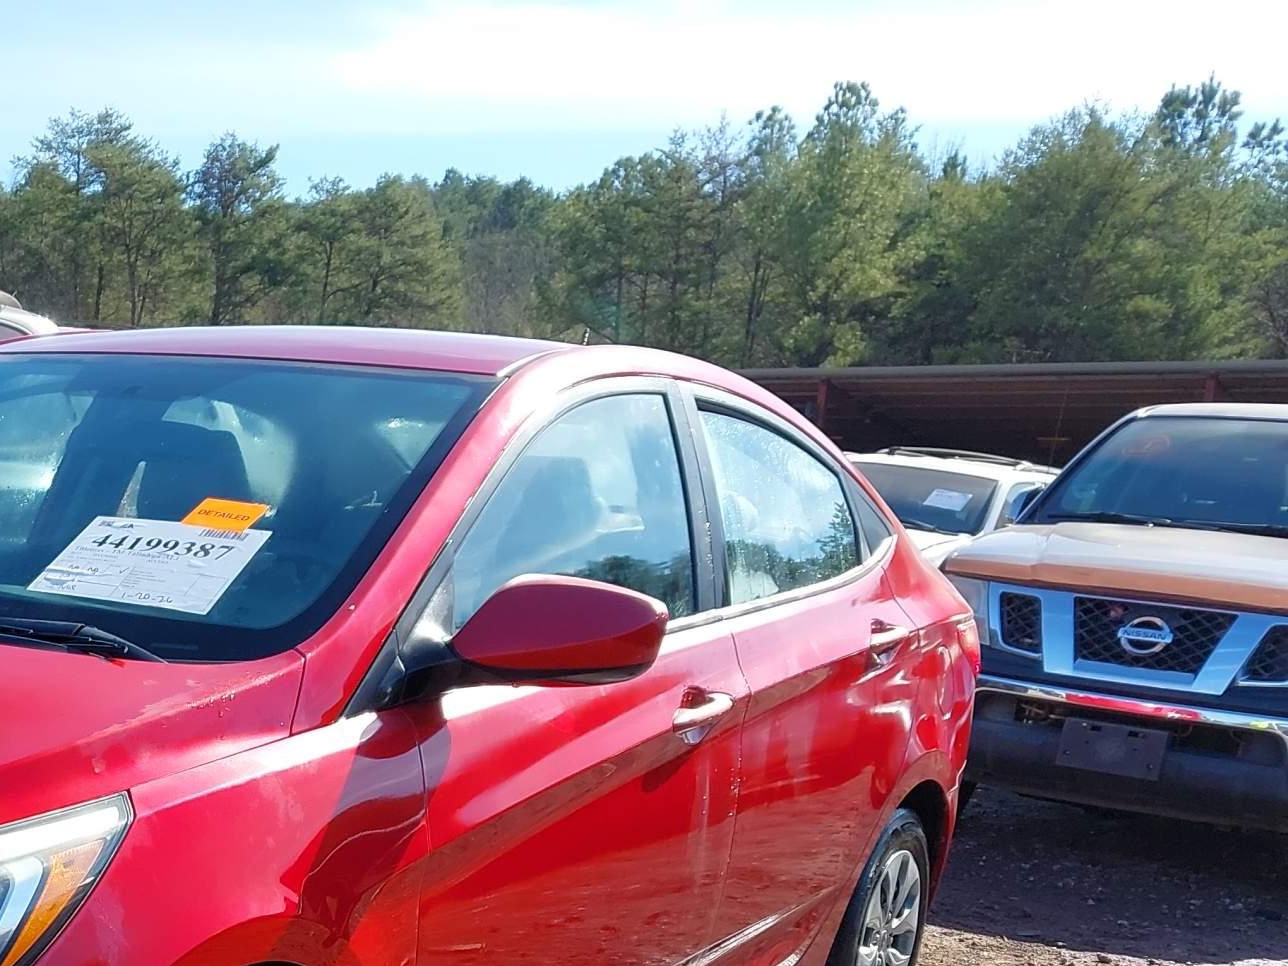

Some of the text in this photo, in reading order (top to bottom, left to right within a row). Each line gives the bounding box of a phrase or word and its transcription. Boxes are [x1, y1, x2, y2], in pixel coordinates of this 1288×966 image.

[198, 508, 250, 521] DETAILED
[92, 533, 235, 561] 44199387
[1121, 629, 1169, 641] NISSAN
